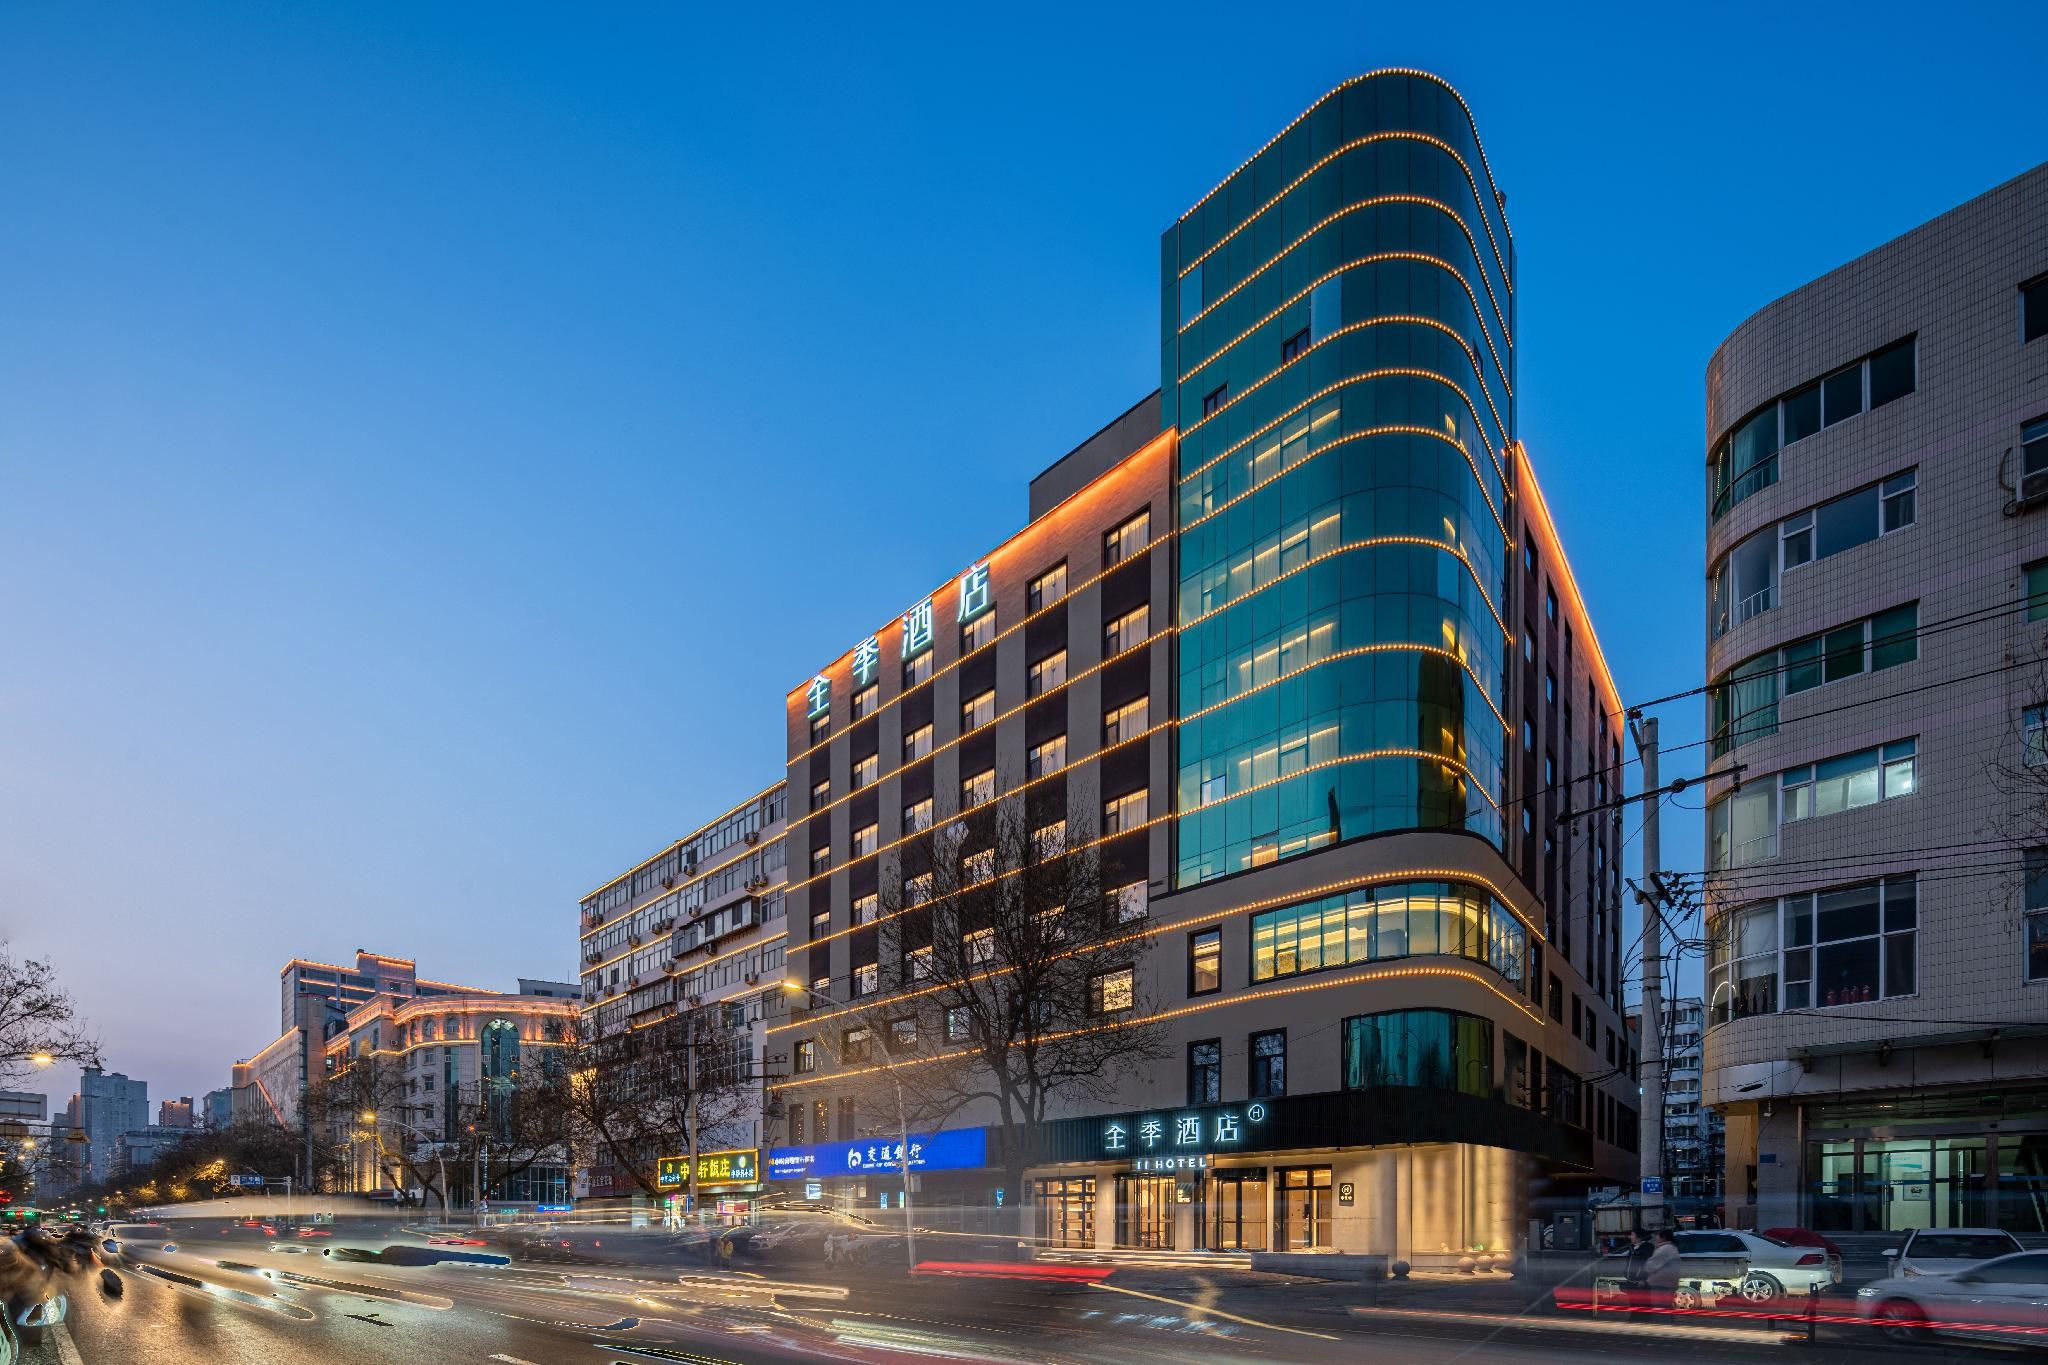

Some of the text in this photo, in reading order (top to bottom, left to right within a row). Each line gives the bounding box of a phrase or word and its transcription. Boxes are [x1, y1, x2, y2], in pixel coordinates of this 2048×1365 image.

[806, 560, 991, 719] 全季酒店
[1104, 1114, 1240, 1149] 全季酒店
[680, 1158, 730, 1180] 中轩饭庄
[1155, 1158, 1207, 1169] HOTEL
